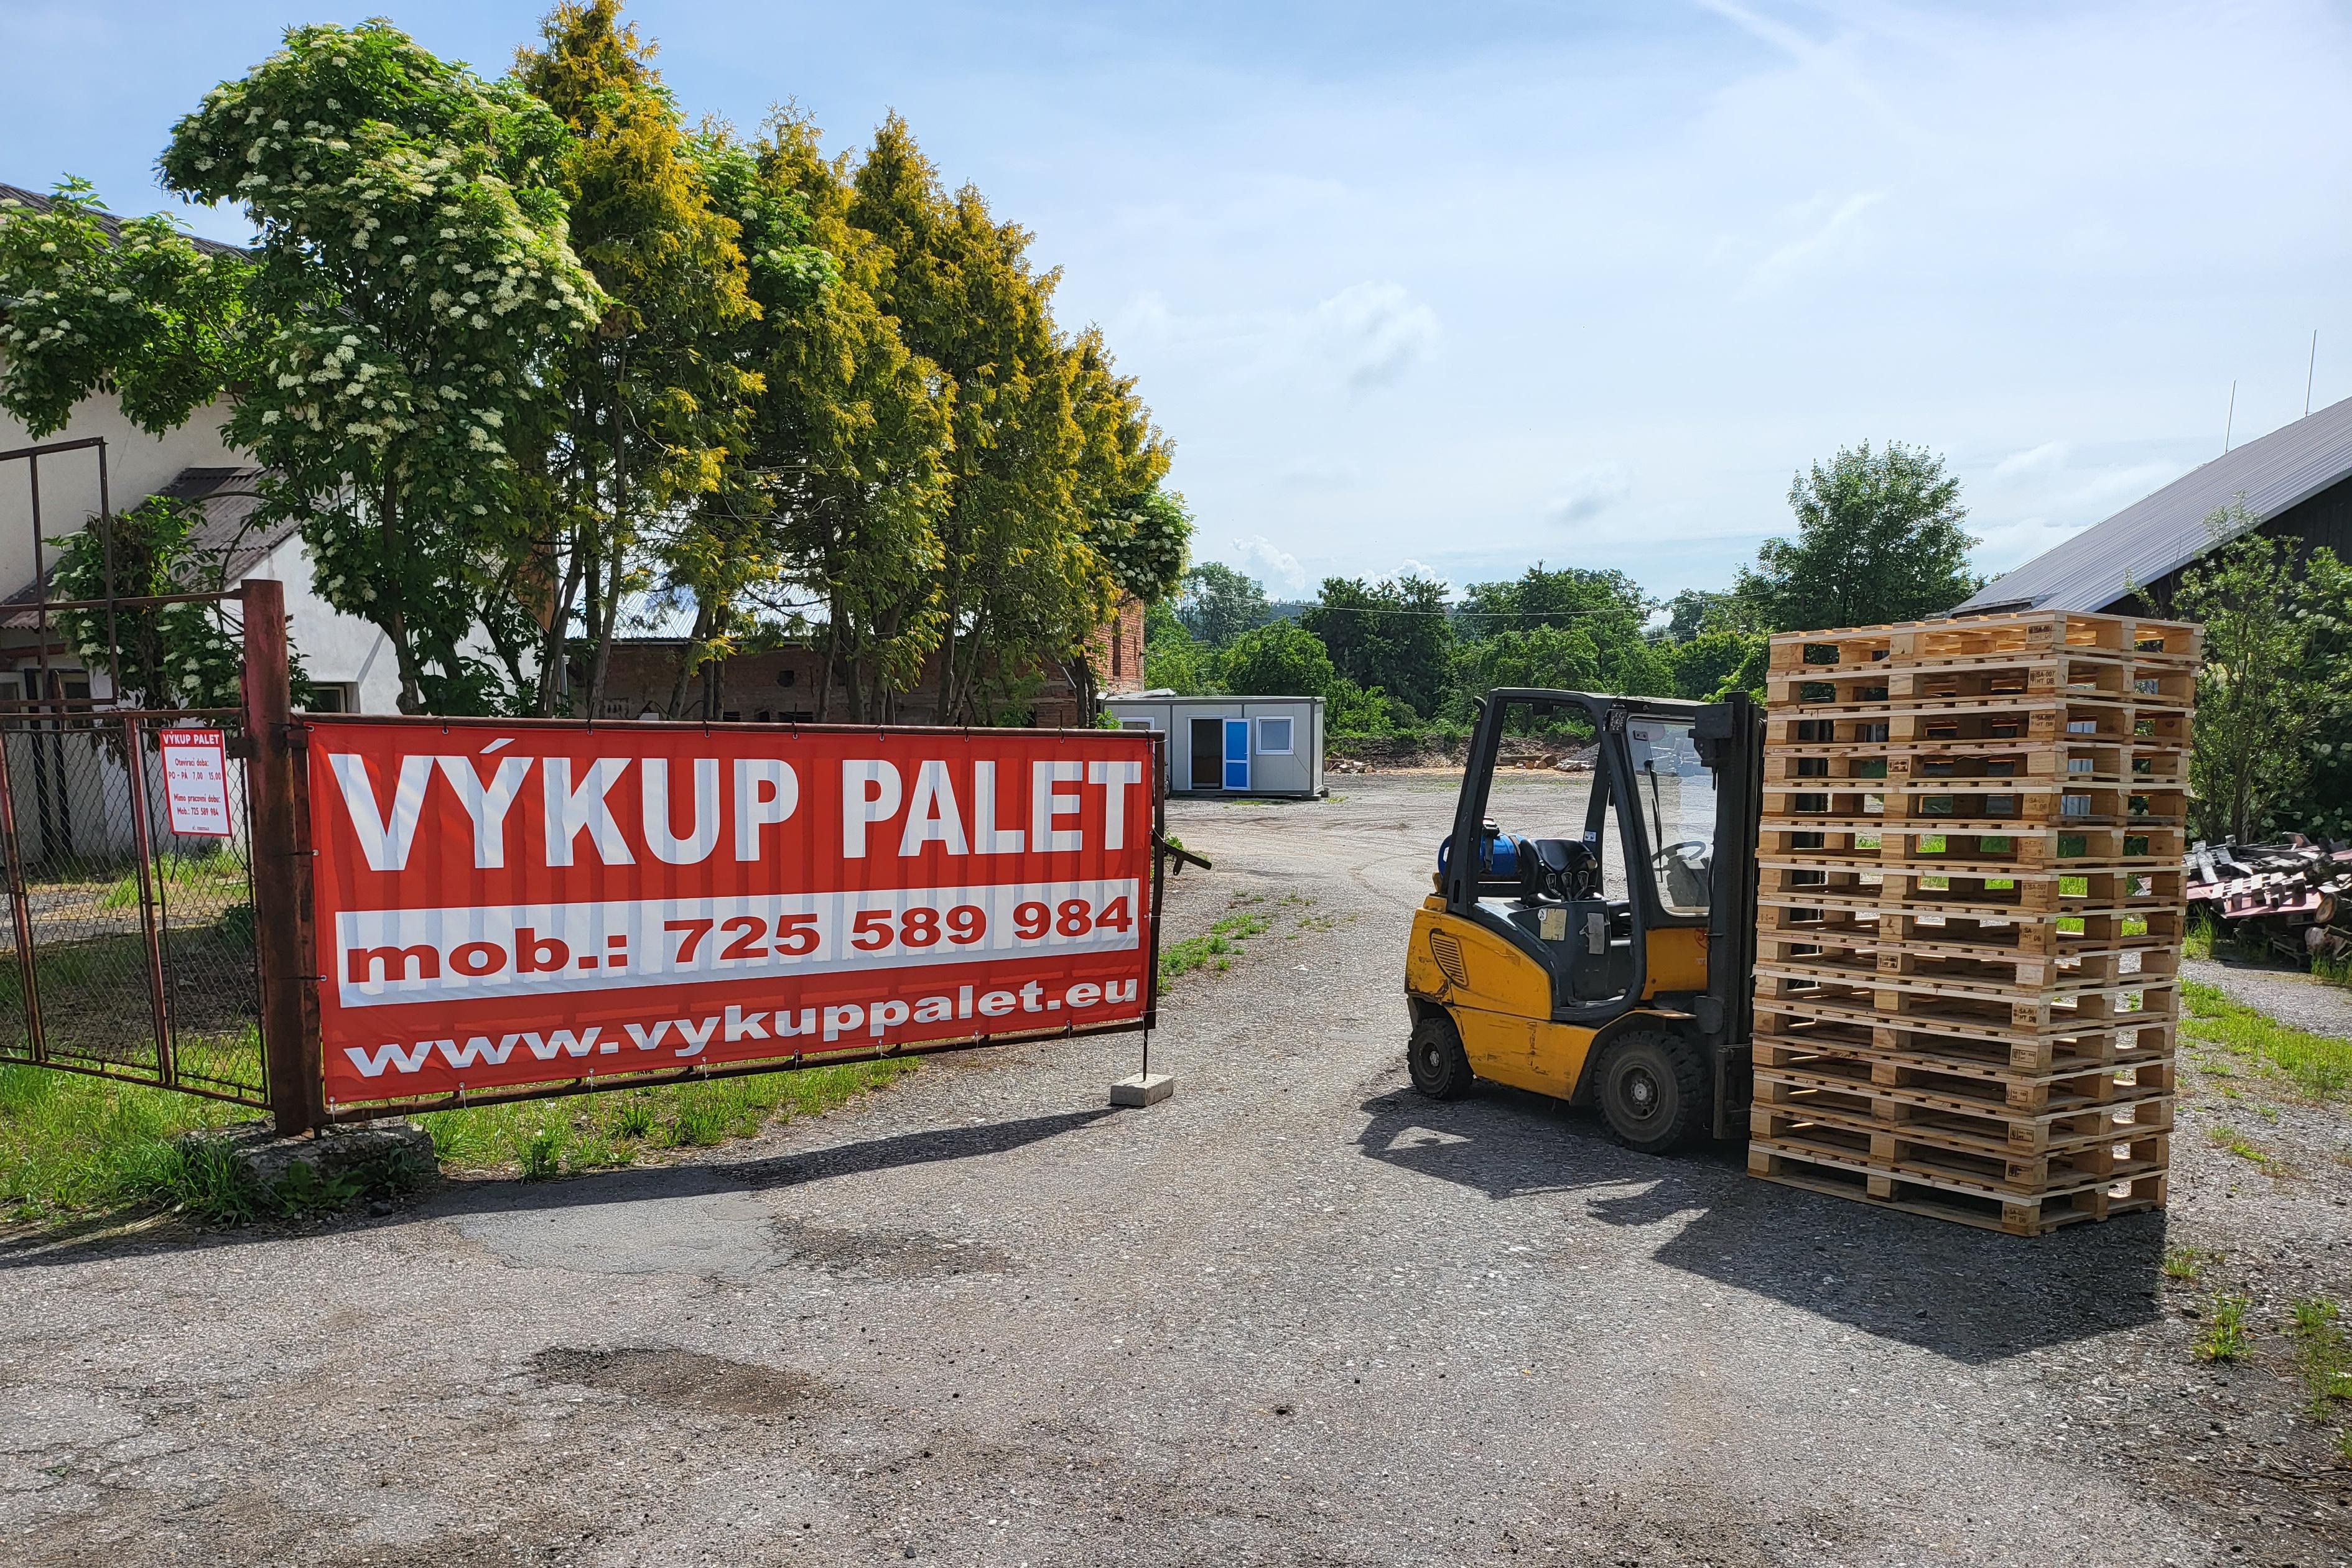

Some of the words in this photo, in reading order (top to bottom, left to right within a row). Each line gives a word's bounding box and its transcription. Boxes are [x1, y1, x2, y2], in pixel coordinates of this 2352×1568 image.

[163, 731, 191, 745] VÝKUP
[193, 734, 220, 745] PALET
[169, 771, 176, 779] PO
[182, 769, 188, 779] PÁ
[193, 772, 203, 781] 7,00
[208, 772, 221, 781] 15,00
[191, 807, 199, 815] 725
[201, 807, 209, 816] 589
[328, 738, 799, 871] VÝKUP
[842, 759, 1142, 858] PALET
[347, 927, 628, 983] mob.:
[664, 913, 820, 963] 725
[852, 905, 988, 951] 589
[1013, 896, 1134, 940] 984
[343, 978, 1138, 1078] www.vykuppalet.eu
